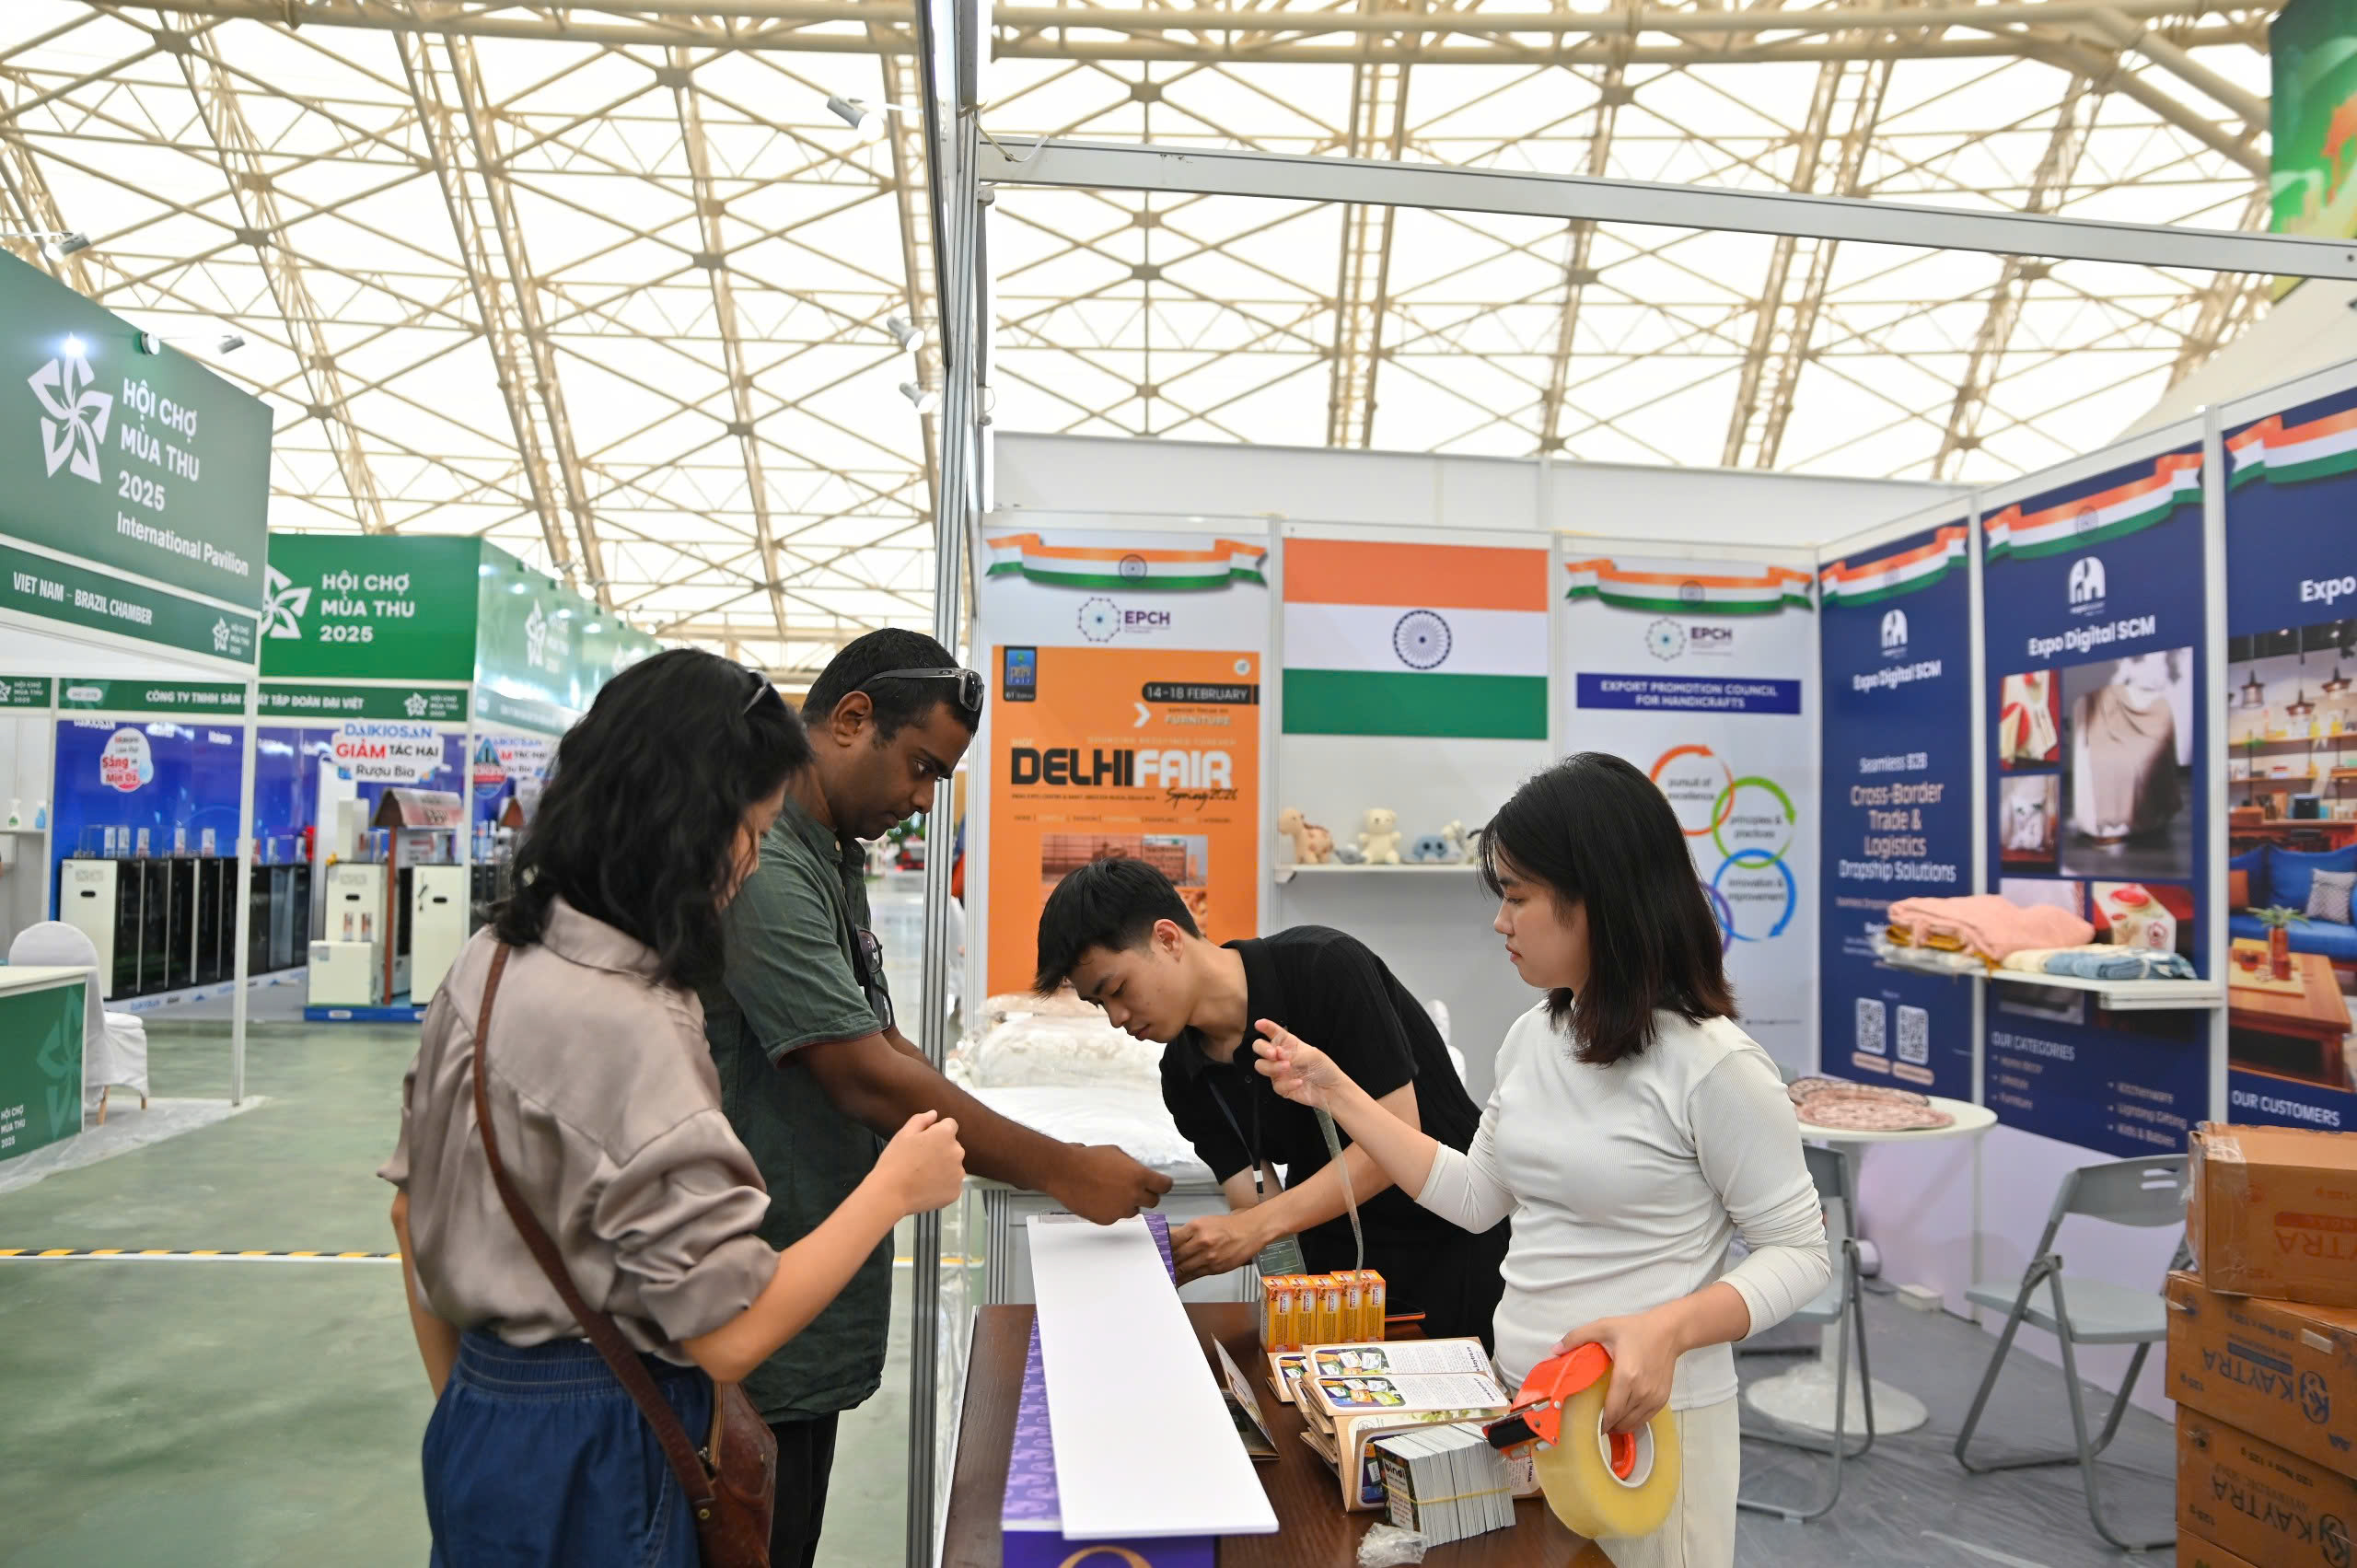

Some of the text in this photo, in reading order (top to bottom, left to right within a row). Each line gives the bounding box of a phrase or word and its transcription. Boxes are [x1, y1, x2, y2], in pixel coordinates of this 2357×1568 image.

[122, 377, 198, 443] HỘI CHỢ
[121, 424, 200, 482] MÙA THU
[118, 470, 166, 511] 2025
[117, 511, 250, 576] International Pavilion
[322, 570, 410, 596] HỘI CHỢ
[2301, 575, 2355, 604] Expo
[13, 571, 38, 590] VIET
[40, 580, 64, 601] NAM
[75, 589, 108, 613] BRAZIL
[110, 598, 153, 625] CHAMBER
[320, 597, 415, 617] MÙA THU
[1125, 610, 1170, 624] EPCH
[319, 625, 373, 642] 2025
[1690, 627, 1732, 640] EPCH
[2029, 615, 2155, 658] Expo Digital SCM
[1852, 659, 1942, 693] Expo Digital SCM
[145, 689, 175, 703] CÔNG
[177, 691, 190, 703] TY
[192, 691, 218, 704] TNHH
[1187, 688, 1248, 700] FEBRUARY
[1601, 680, 1777, 697] EXPORT PROMOTION COUNCIL
[1636, 694, 1745, 708] FOR HANDICRAFTS
[344, 724, 433, 738] DAIKIOSAN
[336, 738, 439, 759] GIẢM TÁC HẠI
[102, 755, 129, 770] Sáng
[355, 764, 415, 777] Rượu Bia
[1860, 754, 1905, 773] Seamless
[1851, 783, 1944, 807] Cross-Border
[1869, 808, 1922, 830] Trade &
[1864, 835, 1926, 859] Logistics
[1840, 859, 1956, 883] Dropship Solutions
[1991, 1031, 2075, 1061] OUR CATEGORIES
[2232, 1090, 2340, 1127] OUR CUSTOMERS
[2201, 1348, 2296, 1402] KAYTRA
[2212, 1476, 2313, 1544] KAYTRA
